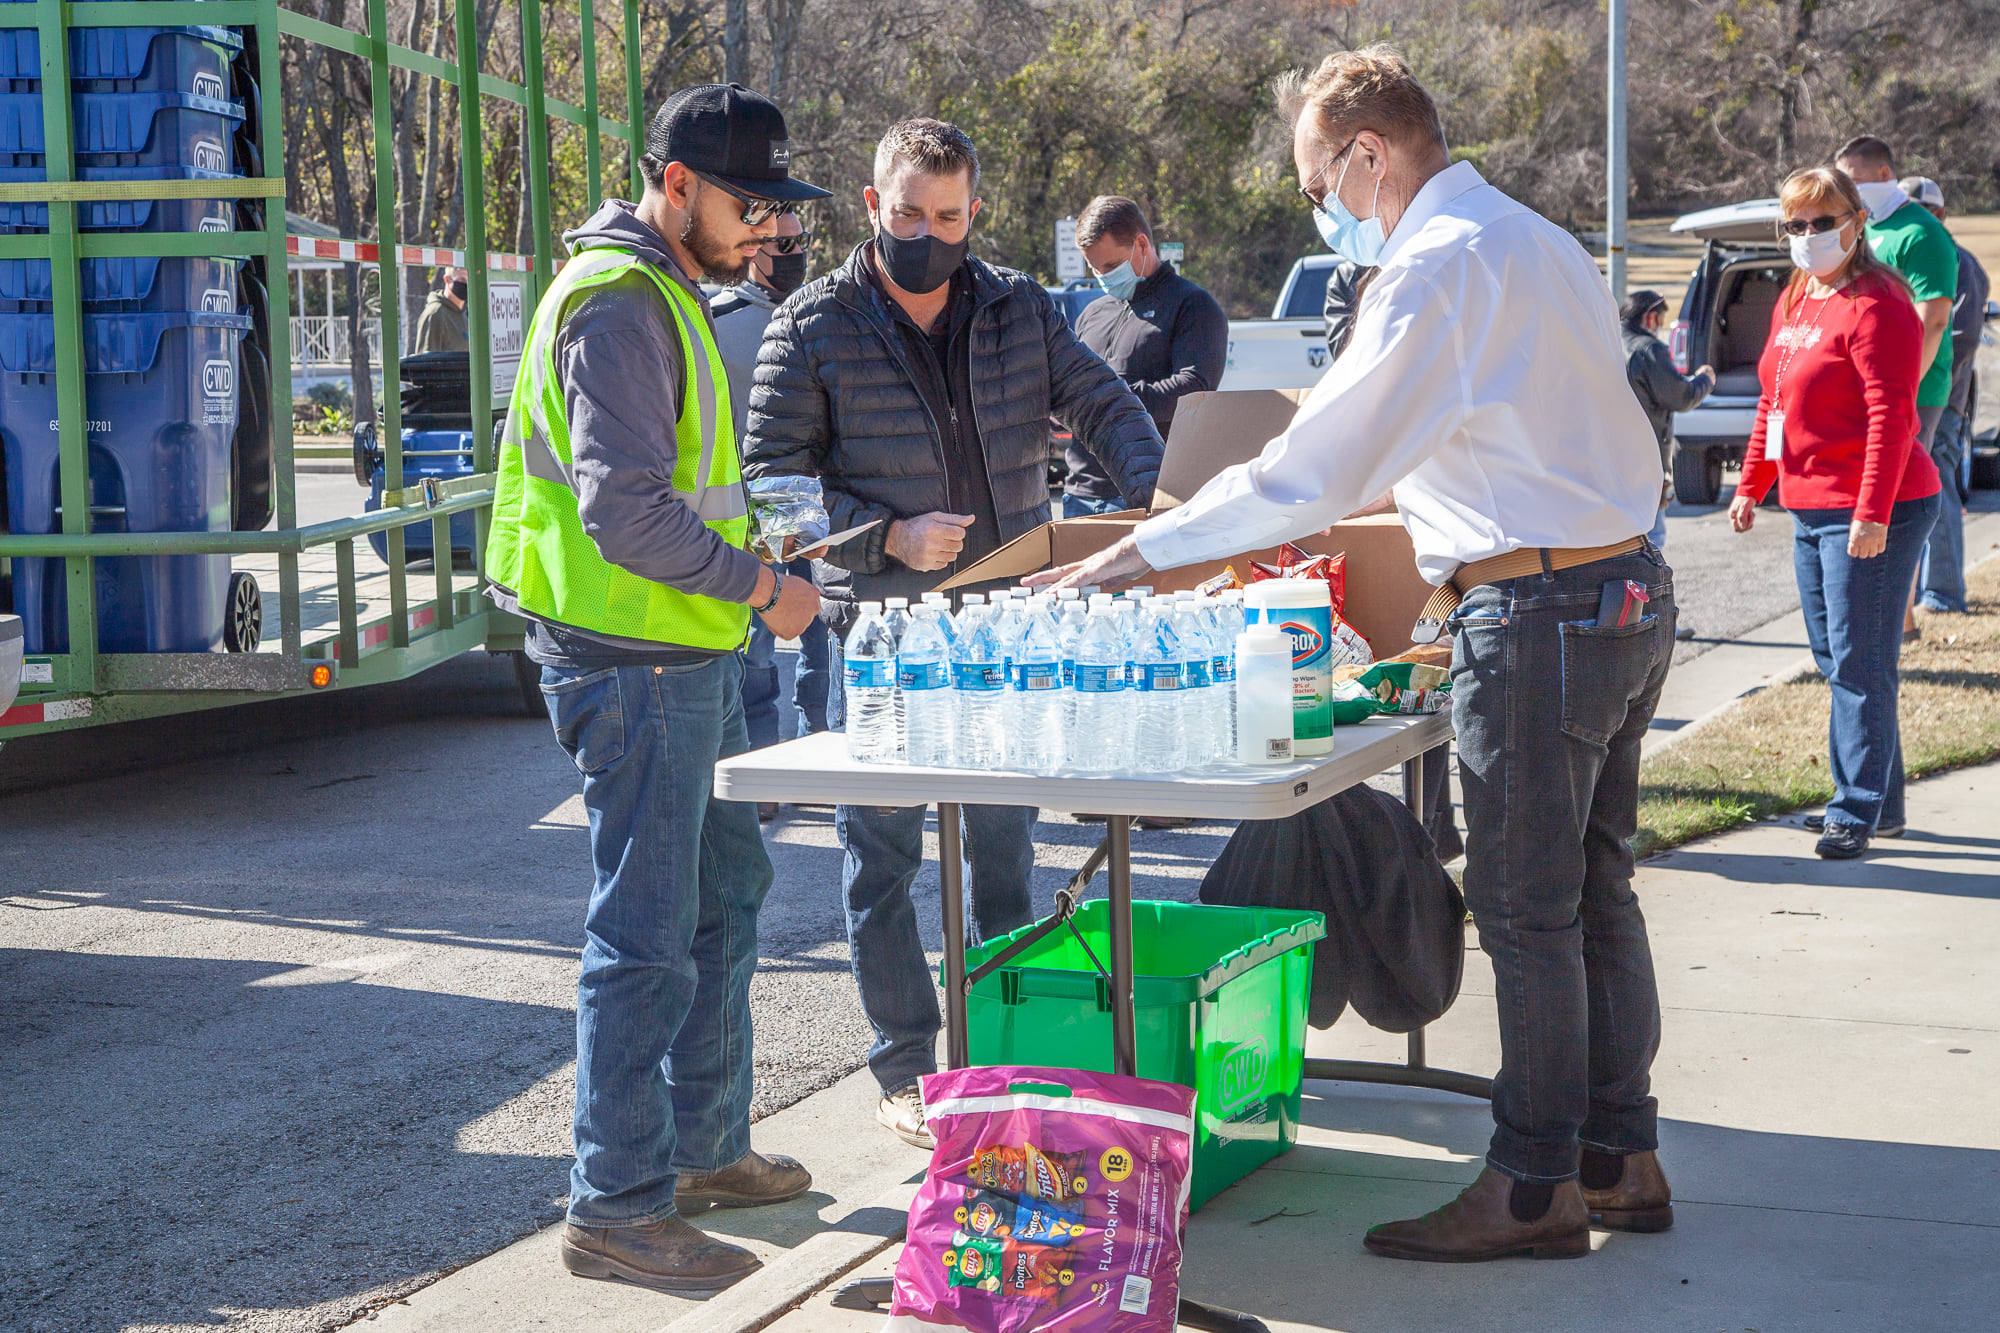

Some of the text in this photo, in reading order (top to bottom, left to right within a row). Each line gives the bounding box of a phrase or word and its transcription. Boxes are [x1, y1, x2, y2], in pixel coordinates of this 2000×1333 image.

[196, 79, 221, 100] CWD
[197, 149, 223, 171] CWD
[205, 296, 229, 312] CWD
[491, 291, 519, 328] Recycle
[206, 367, 230, 389] CWD
[1291, 633, 1316, 650] ROX
[1223, 1047, 1263, 1100] CWD
[982, 1153, 997, 1188] Cheetos
[1107, 1154, 1123, 1174] 18
[1035, 1157, 1054, 1198] Fritos
[1107, 1189, 1119, 1214] MIX
[957, 1211, 965, 1219] 3
[975, 1206, 990, 1230] Lay's
[1024, 1210, 1041, 1238] Doritos
[1098, 1219, 1118, 1271] FLAVOR
[964, 1250, 979, 1276] Lay's
[1016, 1253, 1026, 1289] Doritos
